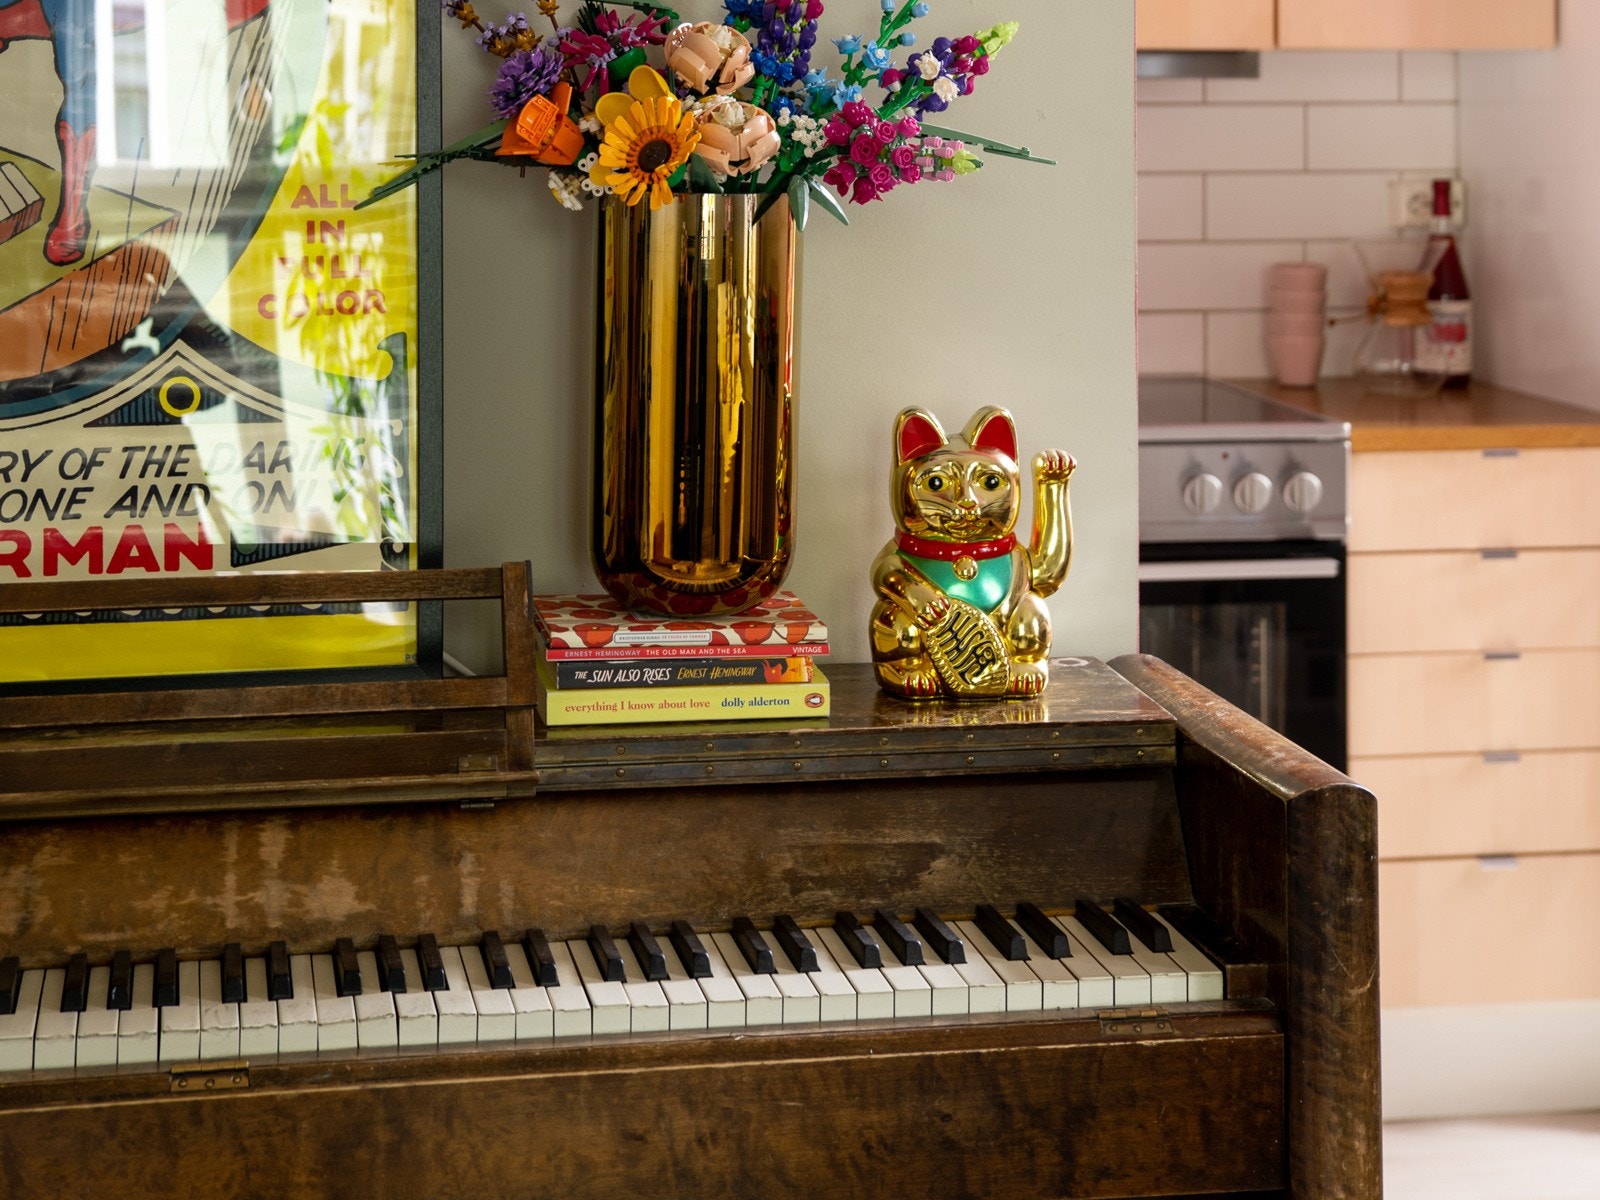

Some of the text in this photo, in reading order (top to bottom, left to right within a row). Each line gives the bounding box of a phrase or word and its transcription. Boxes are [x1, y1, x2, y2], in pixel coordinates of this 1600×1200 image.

[290, 183, 359, 209] ALL
[306, 219, 346, 244] IN
[257, 288, 387, 320] COLOR
[58, 447, 113, 481] OF
[118, 443, 199, 480] THE
[204, 436, 367, 476] DARING
[0, 486, 95, 524] ONE
[103, 482, 211, 519] AND
[0, 521, 214, 578] RMAN
[564, 650, 593, 658] ERNEST
[595, 649, 641, 657] HEMINGWAY
[662, 648, 678, 656] OLD
[716, 647, 731, 655] THE
[792, 646, 823, 654] VINTAGE
[574, 666, 758, 684] THE SUN ALSO RISES ERNEST HEMINGWAY
[564, 696, 790, 713] everything I know about love dolly alderton
